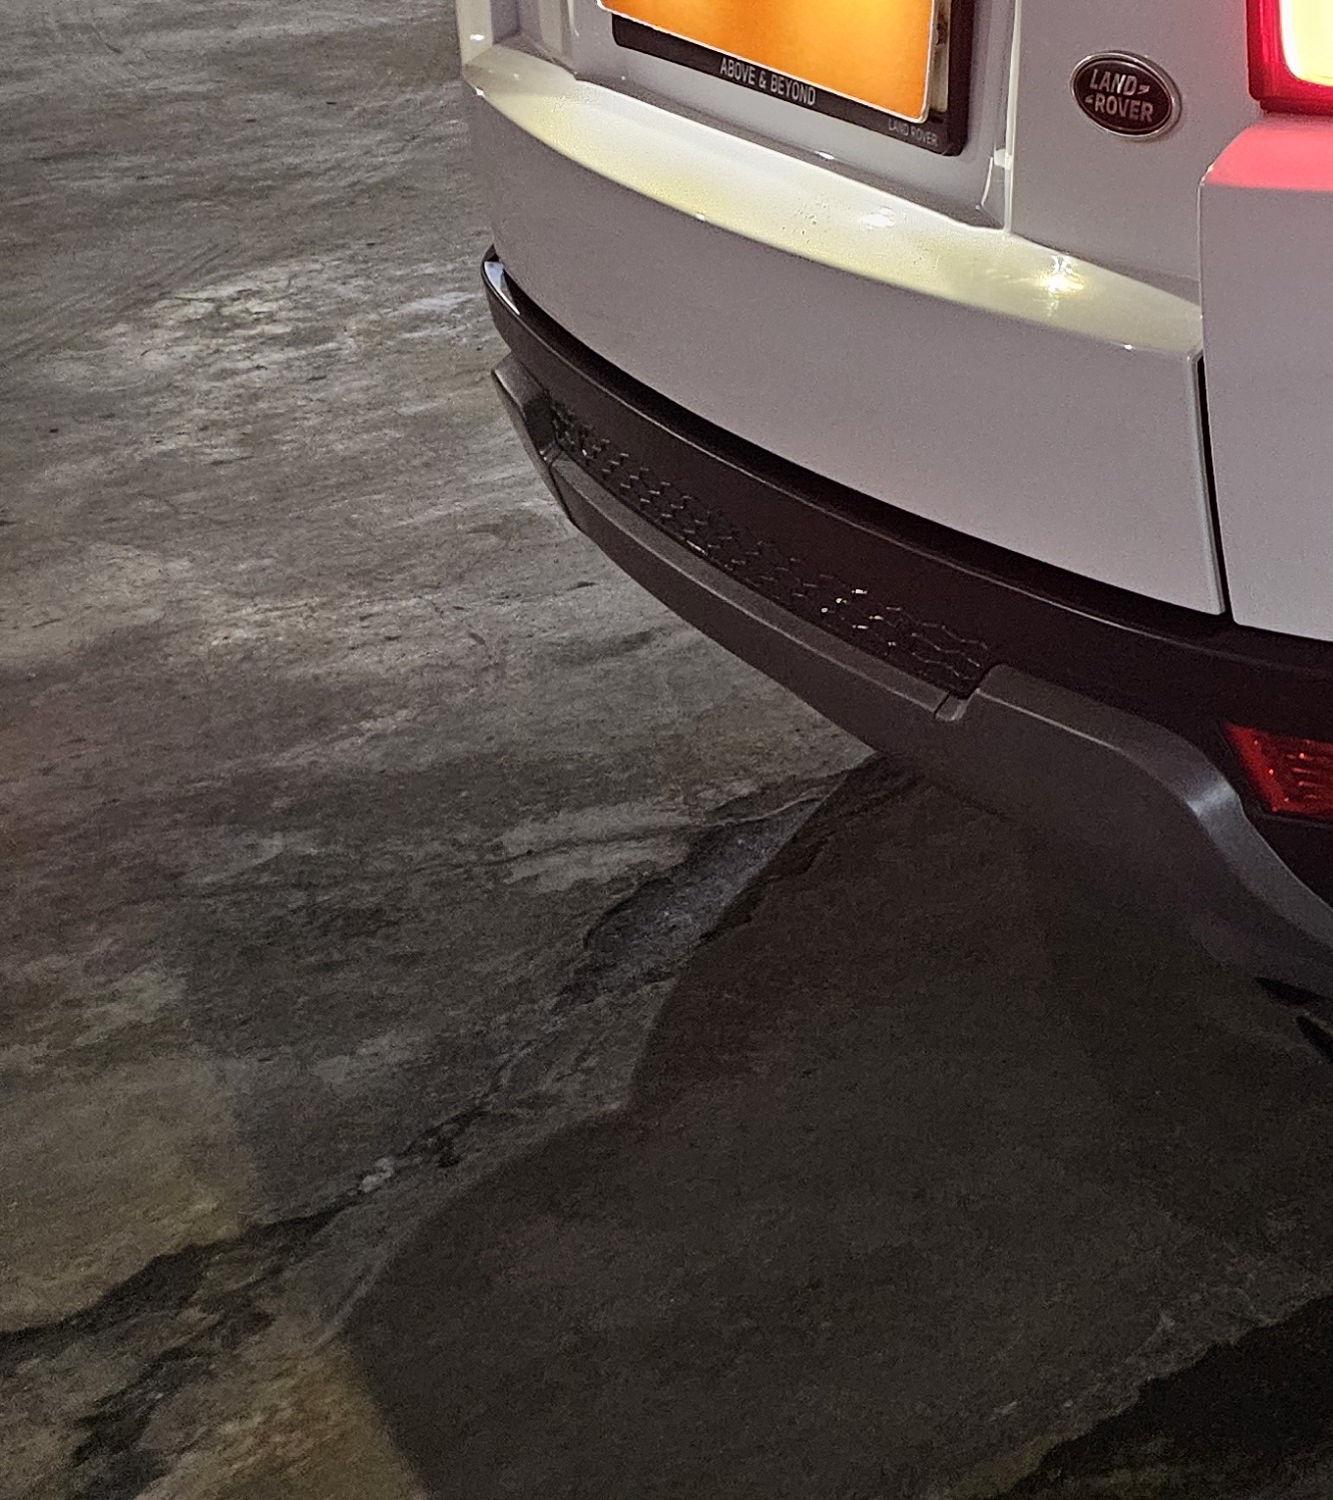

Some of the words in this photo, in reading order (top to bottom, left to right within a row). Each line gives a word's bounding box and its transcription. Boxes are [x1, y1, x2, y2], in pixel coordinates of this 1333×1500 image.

[719, 56, 756, 86] ABOVE
[770, 73, 816, 107] BEYOND
[1089, 68, 1138, 96] LAND
[1094, 92, 1154, 123] ROVER
